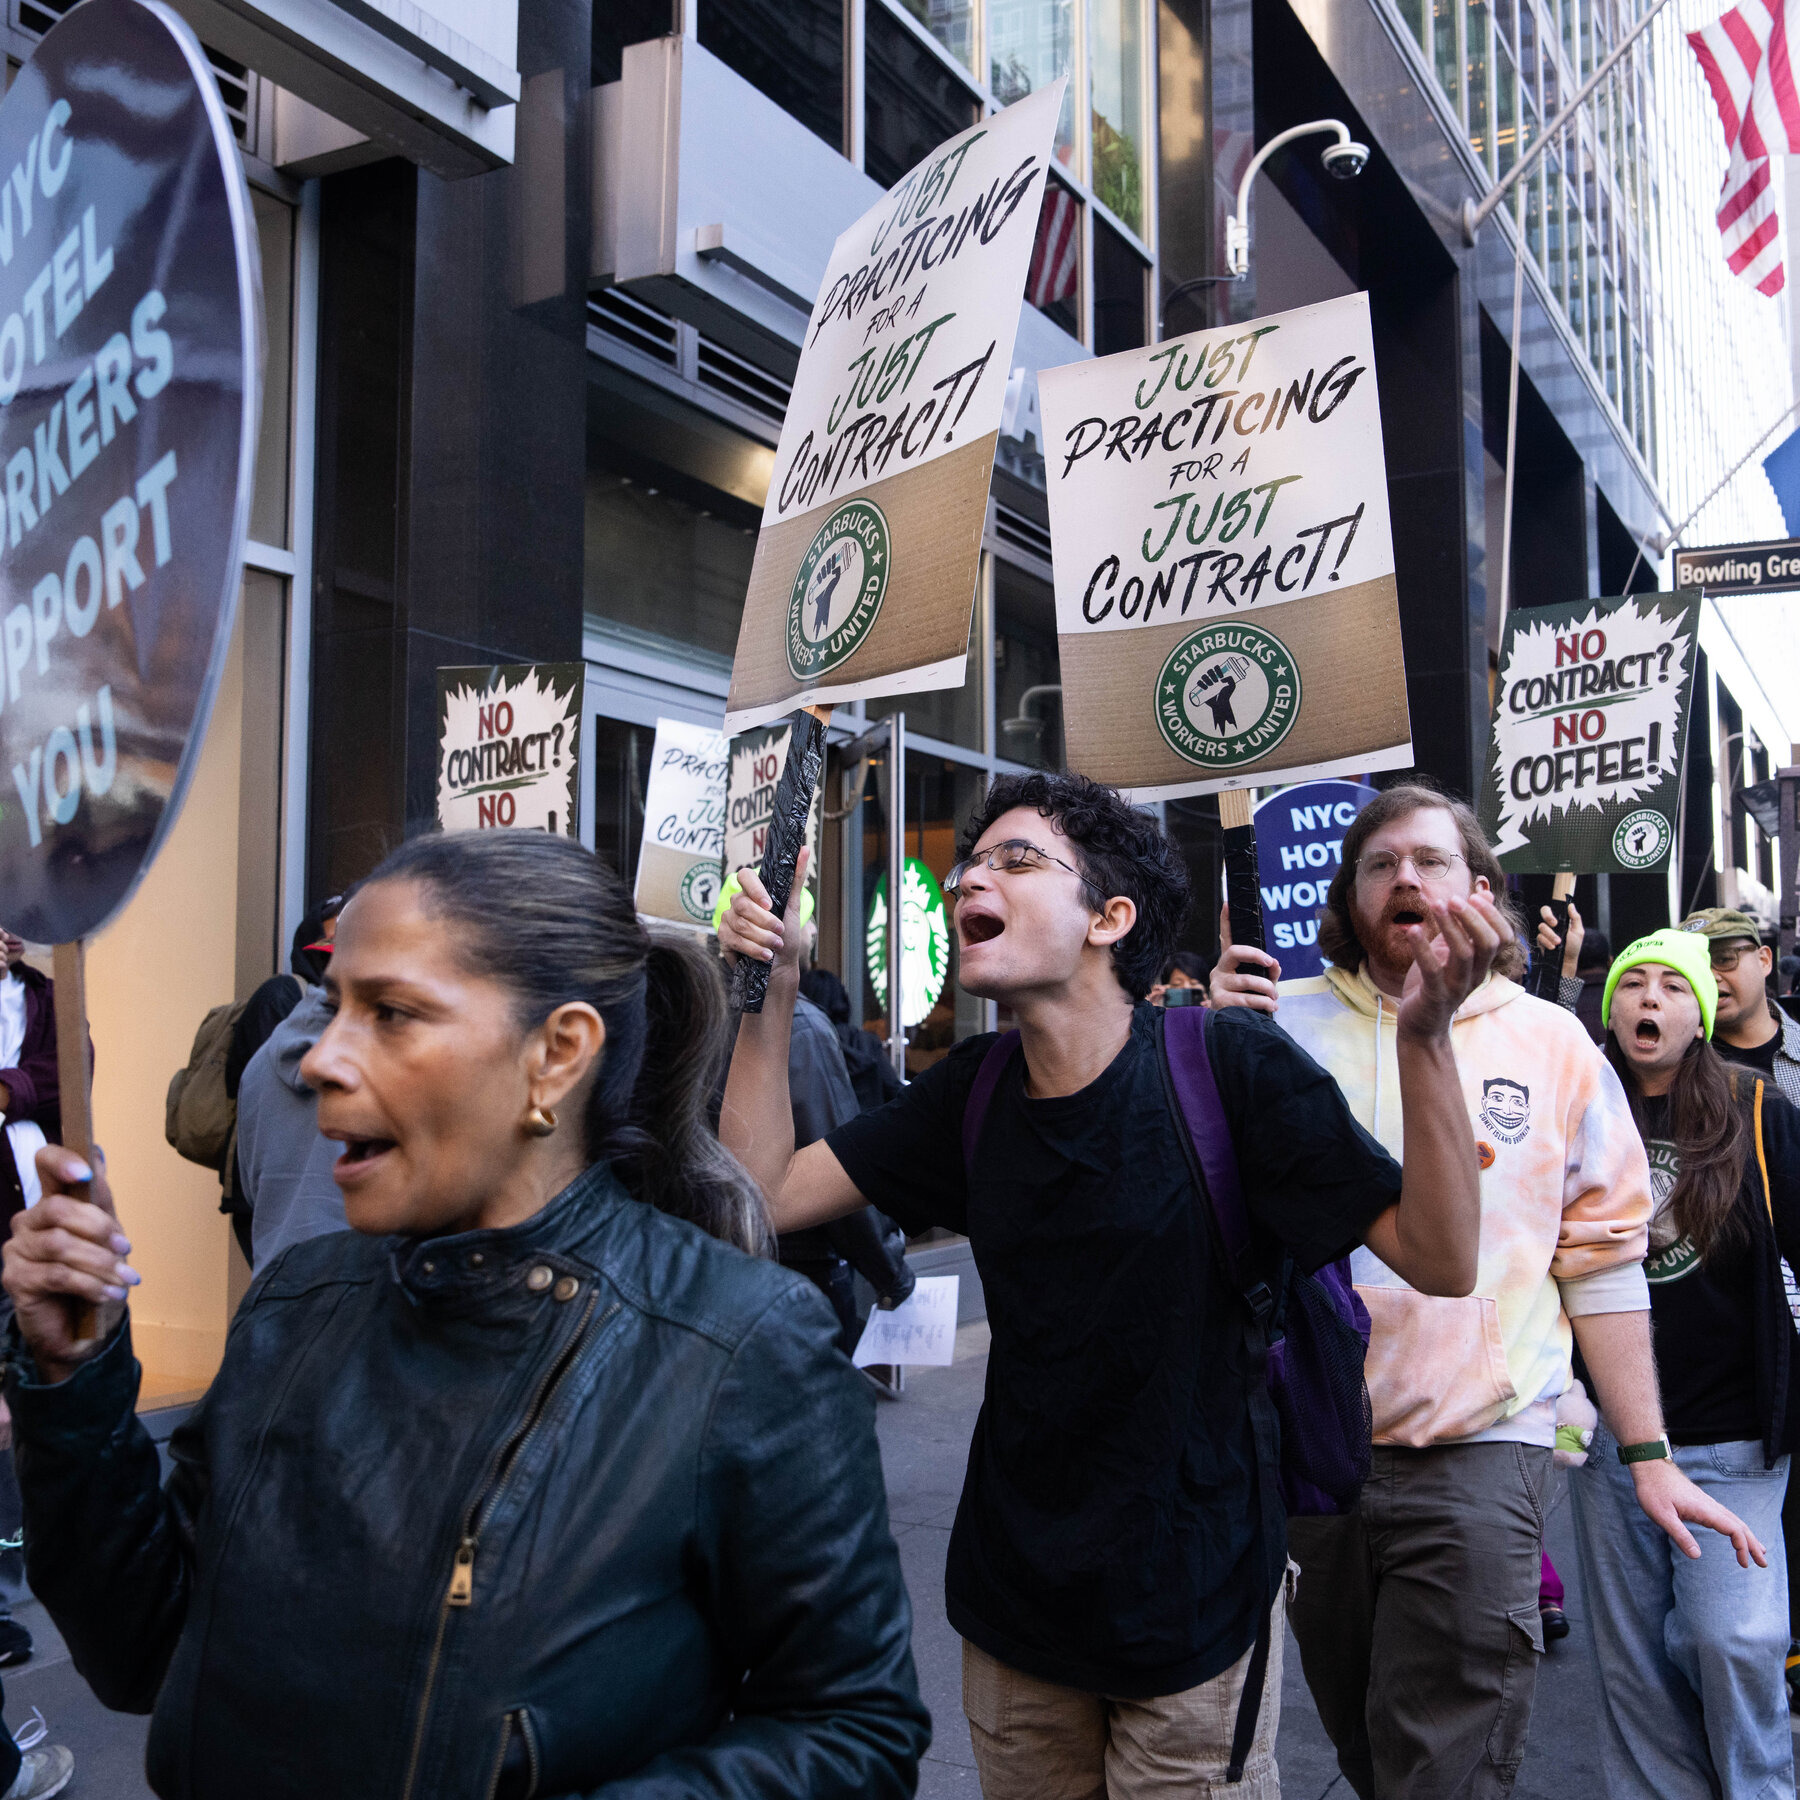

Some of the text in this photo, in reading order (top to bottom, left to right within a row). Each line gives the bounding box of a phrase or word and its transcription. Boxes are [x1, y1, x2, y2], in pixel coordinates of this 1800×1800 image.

[871, 130, 988, 256] JUST
[809, 155, 1040, 350] PRACTICING
[863, 283, 928, 346] FOR A
[827, 312, 957, 435] JUST
[1134, 325, 1280, 410] JUST
[0, 289, 174, 562] RKERS
[778, 339, 996, 515] CONTRACT!
[1061, 355, 1367, 480] PRACTICING
[1169, 446, 1251, 490] FOR A
[808, 513, 880, 568] STARBUCKS
[1141, 474, 1304, 563] JUST
[0, 450, 178, 718] PPORT
[1082, 502, 1366, 624] CONTRACT!
[1680, 555, 1800, 585] Bowling Gre
[789, 574, 880, 668] WORKERS UNITED
[1555, 628, 1607, 668] NO
[1173, 631, 1276, 676] STARBUCKS
[1509, 642, 1675, 714] CONTRACT?
[478, 701, 514, 741] NO
[1162, 684, 1292, 758] WORKERS UNITED
[1552, 709, 1607, 748] NO
[12, 684, 118, 848] YOU
[447, 722, 565, 789] CONTRACT?
[753, 754, 777, 788] NO
[1509, 721, 1663, 801] COFFEE!
[478, 792, 516, 829] NO
[753, 827, 768, 857] N
[1290, 801, 1357, 832] NYC
[1622, 812, 1665, 830] STARBUCKS
[1280, 839, 1343, 871] HOT
[1616, 836, 1667, 865] WORKERS UNITED
[1273, 919, 1322, 949] SU
[1479, 1112, 1494, 1131] CONEY
[1493, 1130, 1512, 1144] ISLAND
